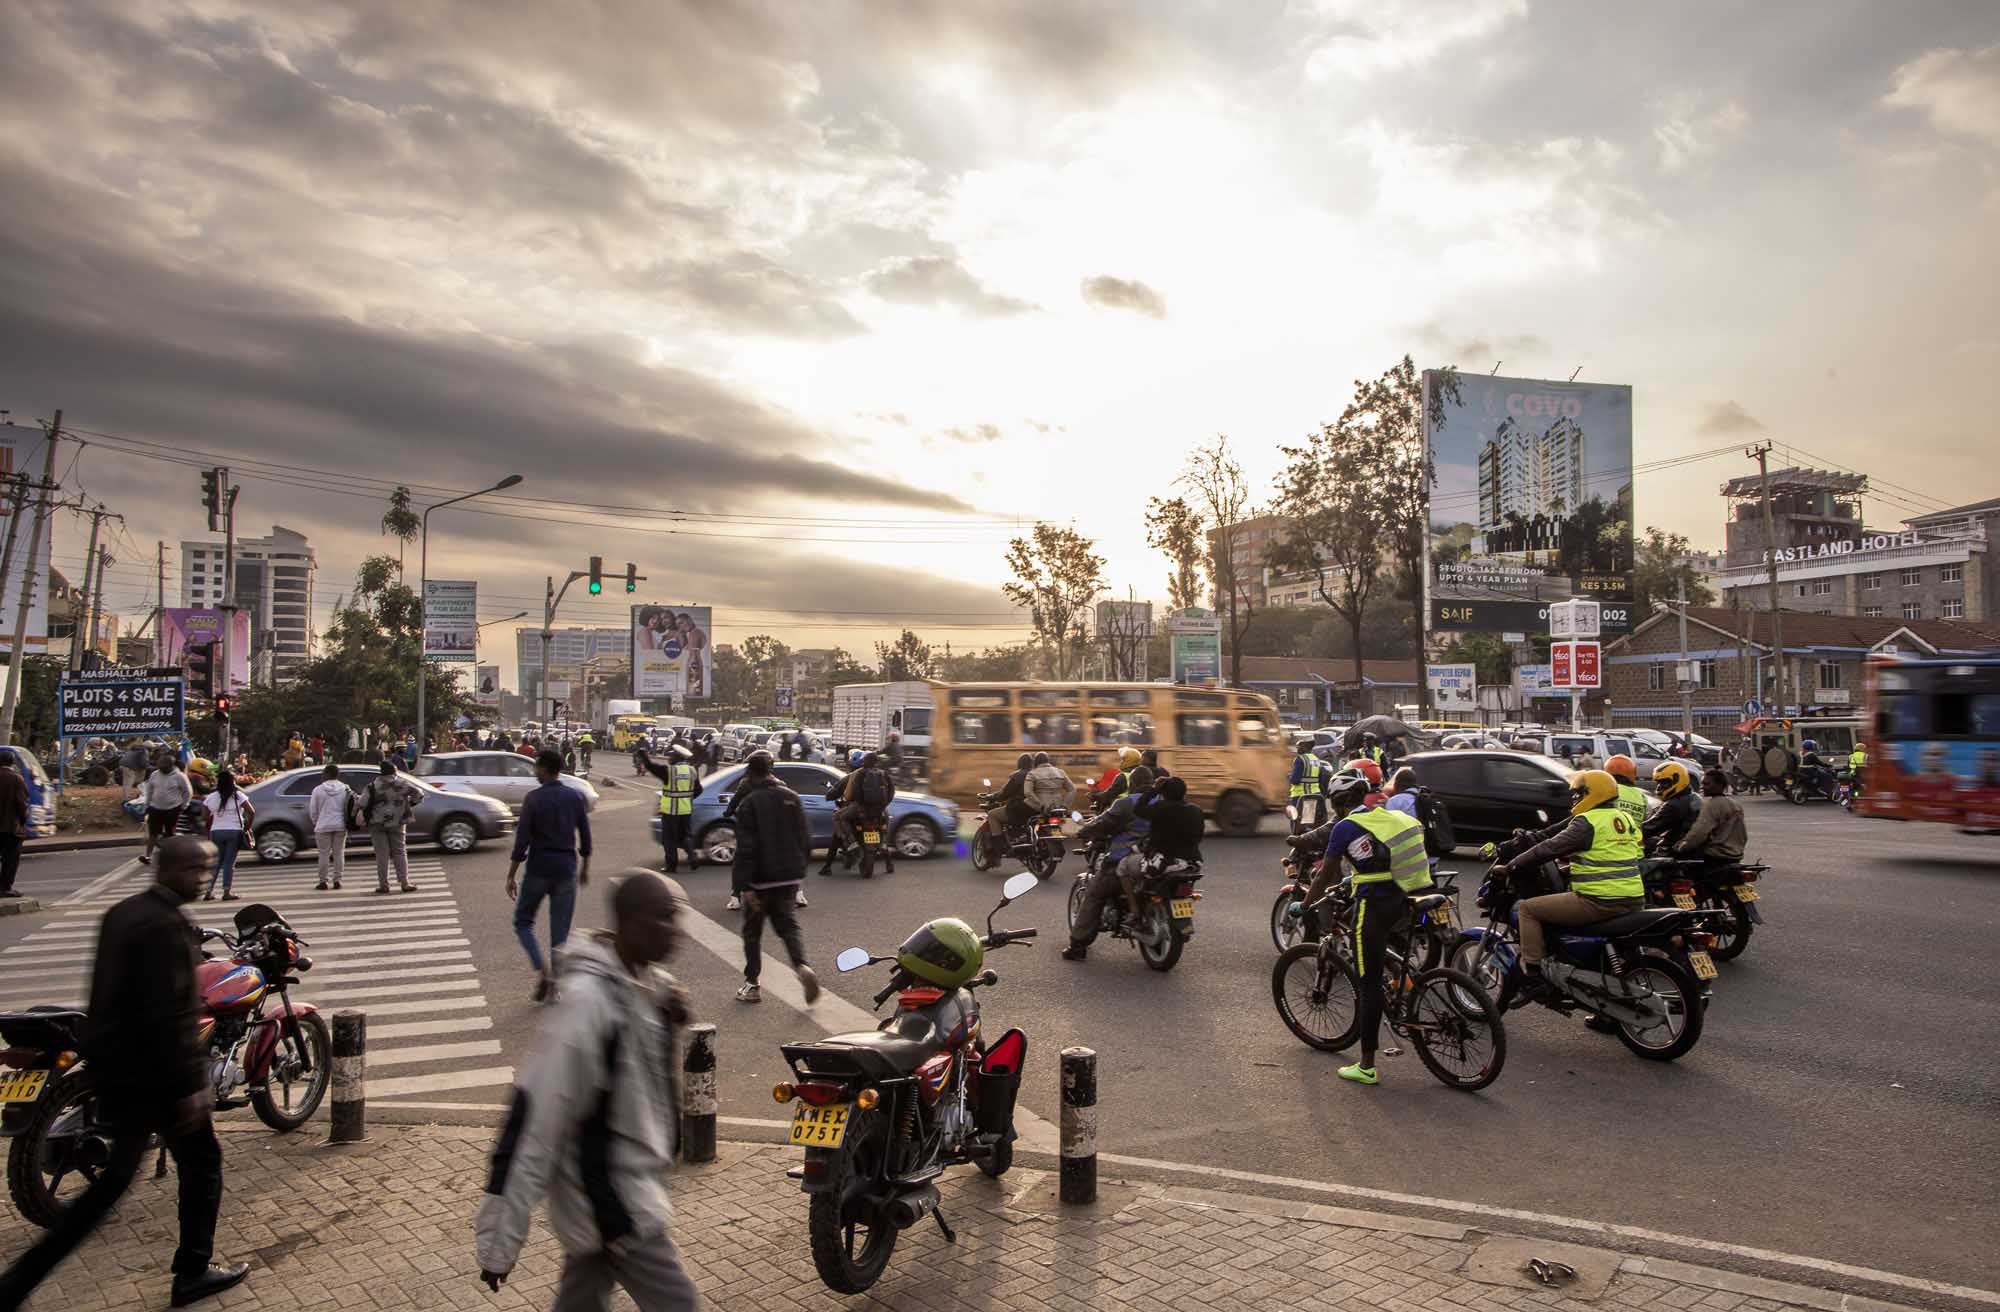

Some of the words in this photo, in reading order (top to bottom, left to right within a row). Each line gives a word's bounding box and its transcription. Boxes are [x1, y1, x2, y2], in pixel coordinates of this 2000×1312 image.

[1506, 393, 1582, 416] COVO
[1861, 531, 1922, 550] HOTEL
[1498, 567, 1545, 576] BEDROOM
[1476, 575, 1501, 583] YEAR
[1504, 576, 1528, 584] PLAN
[1580, 581, 1600, 590] KES
[1602, 582, 1626, 591] 3.5M
[1441, 607, 1473, 620] SAIF
[1603, 609, 1627, 621] 002
[80, 669, 148, 679] MASHALLAH
[1578, 670, 1596, 681] YEGO
[1440, 679, 1461, 688] CENTRE
[63, 688, 113, 703] PLOTS
[118, 690, 129, 702] 4
[133, 687, 175, 702] SALE
[64, 707, 79, 718] WE
[82, 707, 102, 718] BUY
[113, 707, 136, 717] SELL
[142, 707, 173, 717] PLOTS
[793, 1125, 841, 1141] 075T
